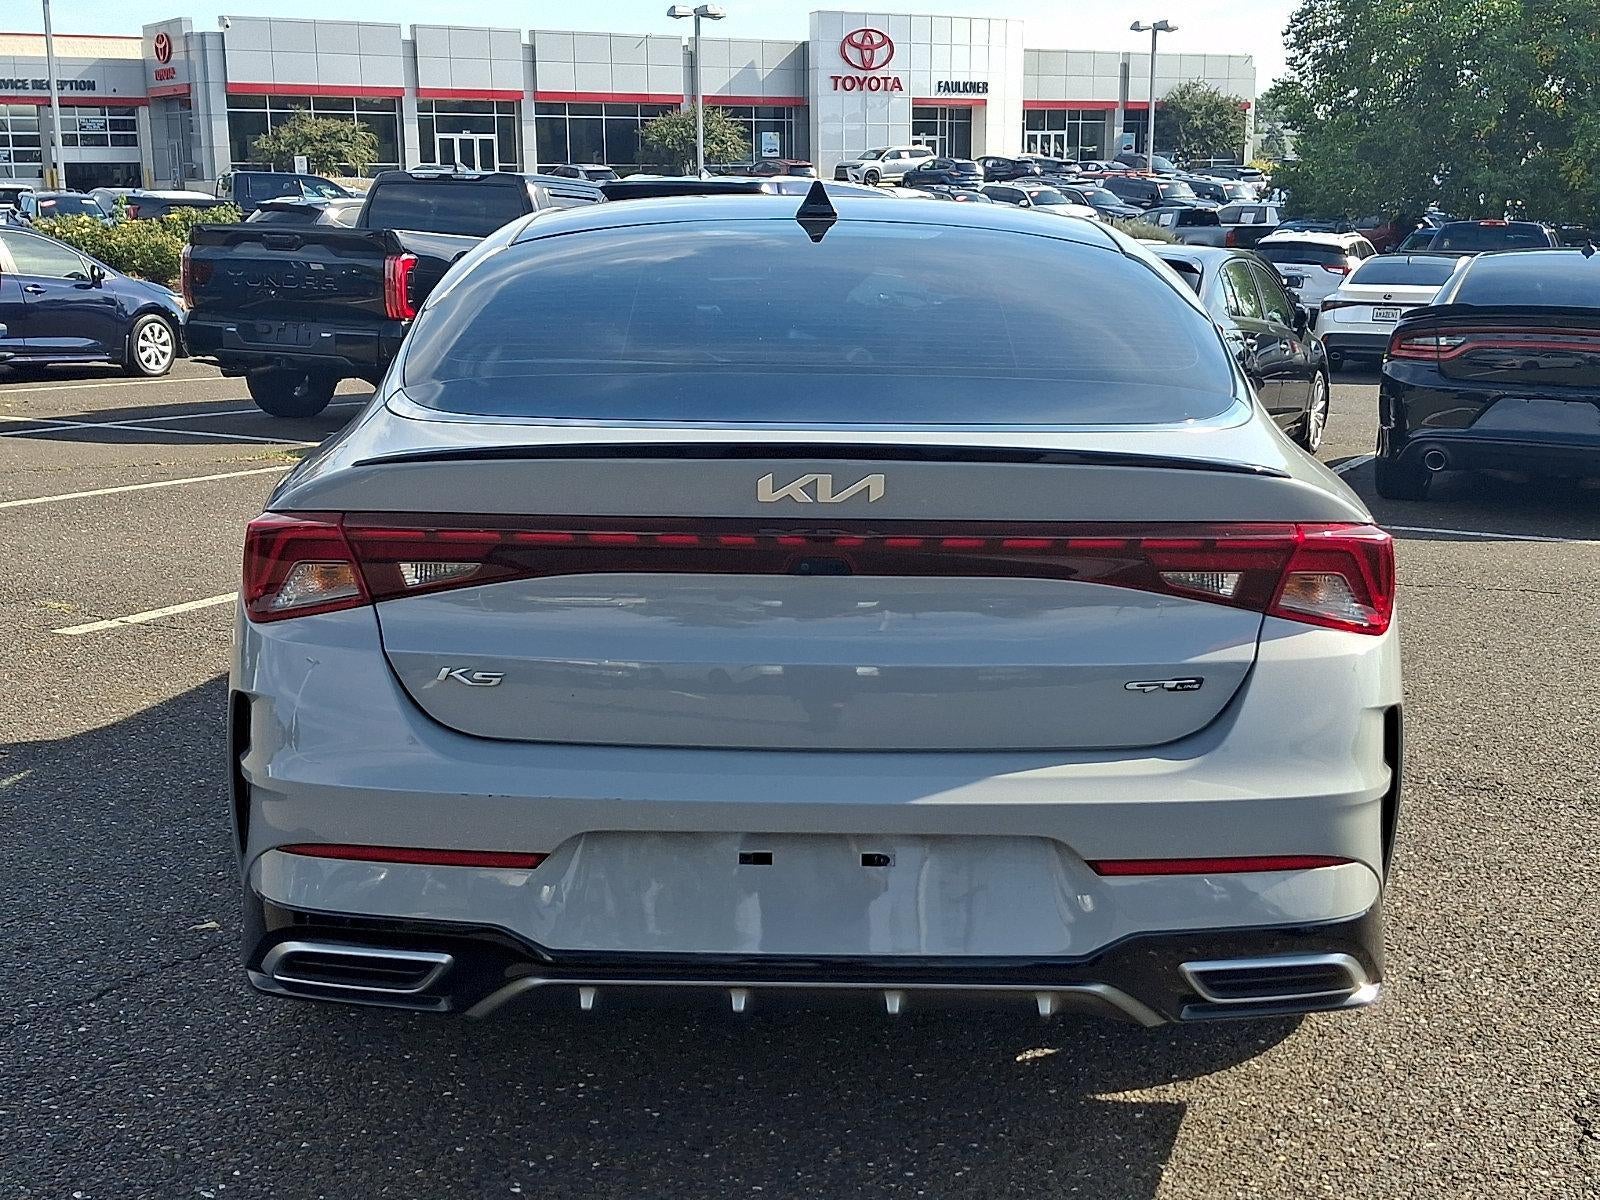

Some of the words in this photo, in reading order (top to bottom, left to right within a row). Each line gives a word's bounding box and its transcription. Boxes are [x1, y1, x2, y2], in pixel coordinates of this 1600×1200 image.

[831, 75, 903, 92] TOYOTA
[937, 80, 989, 94] FAULKNER
[226, 270, 338, 291] TUNDRA
[757, 472, 885, 503] KIA
[436, 667, 506, 687] K5
